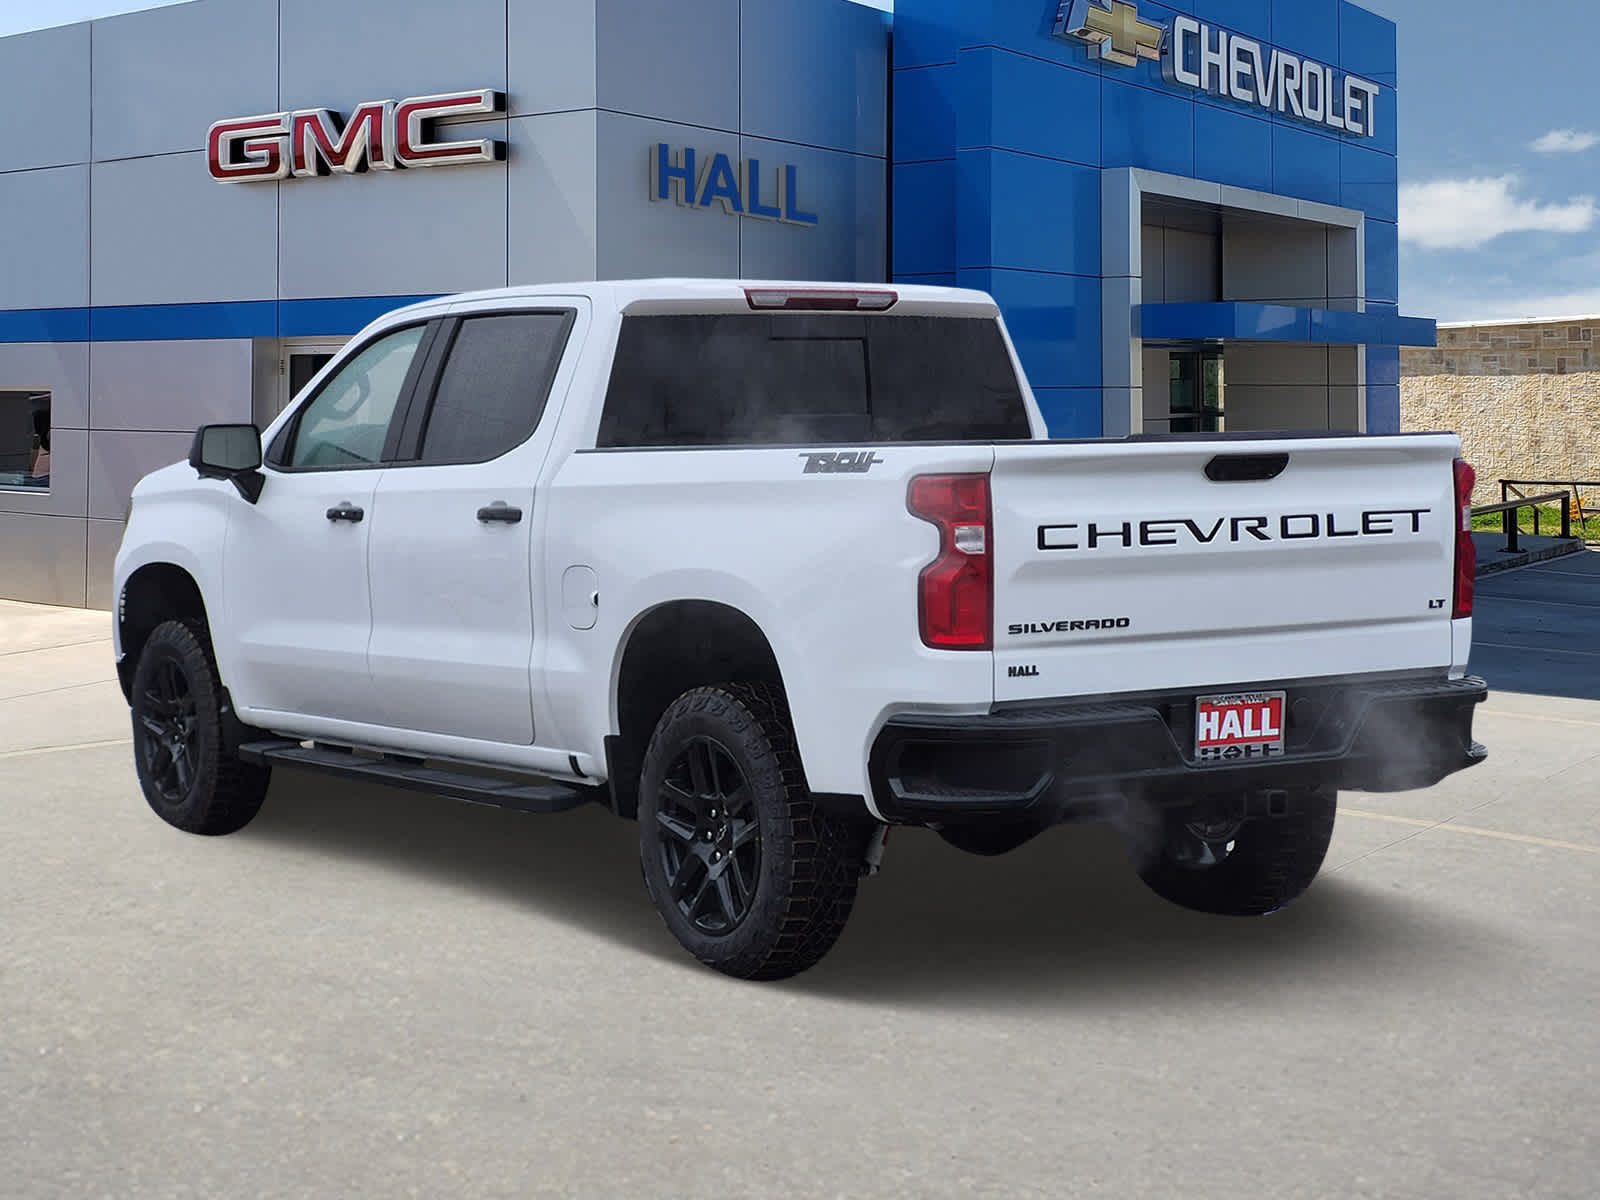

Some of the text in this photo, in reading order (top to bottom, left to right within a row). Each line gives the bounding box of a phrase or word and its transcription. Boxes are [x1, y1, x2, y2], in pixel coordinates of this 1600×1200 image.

[1173, 15, 1379, 137] CHEVROLET
[206, 88, 507, 185] GMC
[652, 143, 818, 226] HALL
[1037, 509, 1431, 551] CHEVROLET
[1428, 599, 1446, 609] LT
[1008, 617, 1130, 635] SILVERADO
[1007, 664, 1040, 678] HALL
[1198, 707, 1280, 741] HALL
